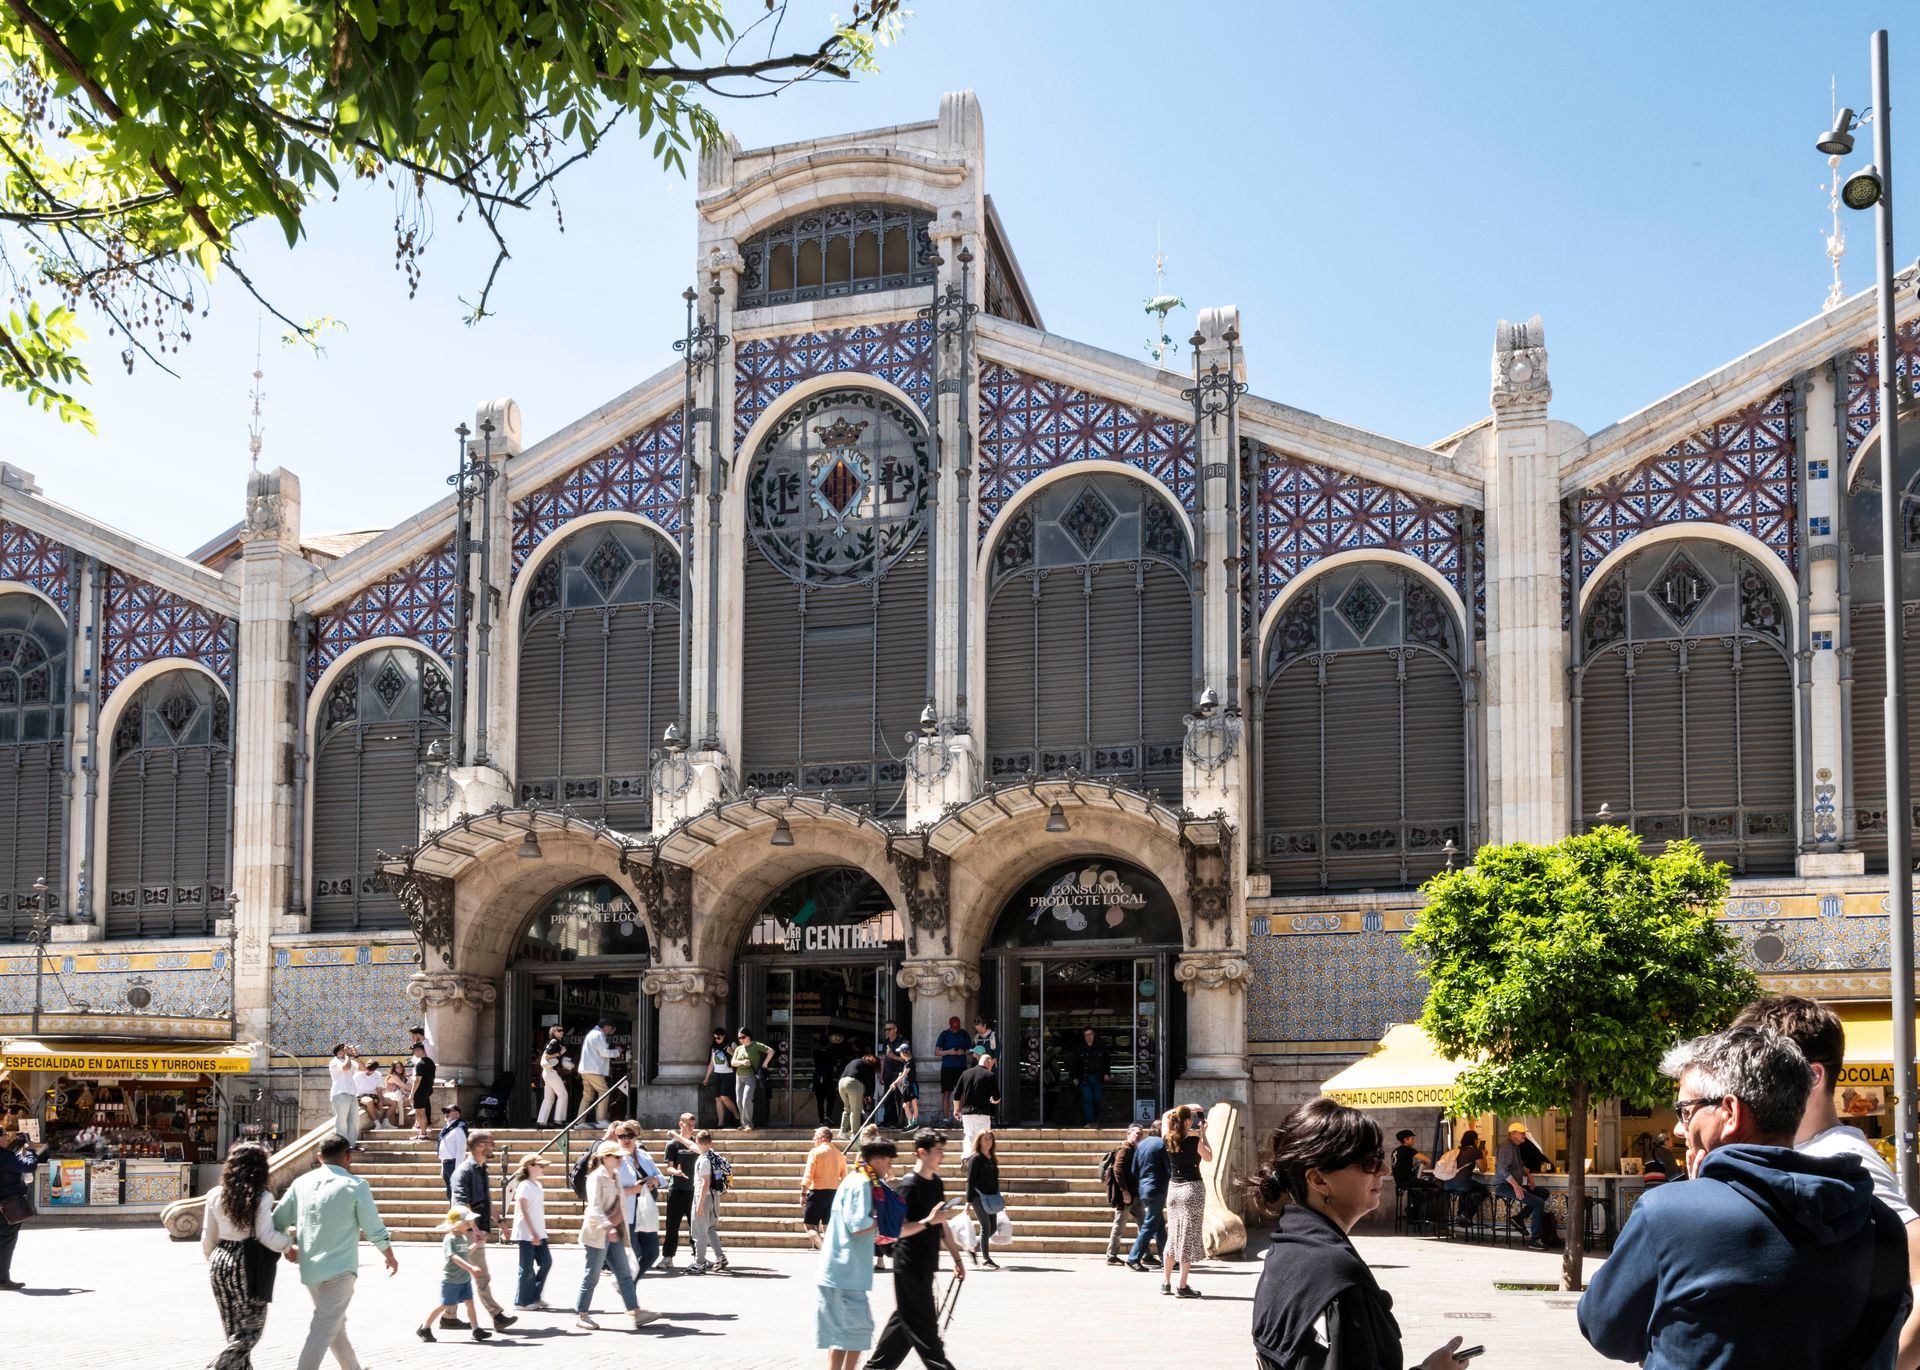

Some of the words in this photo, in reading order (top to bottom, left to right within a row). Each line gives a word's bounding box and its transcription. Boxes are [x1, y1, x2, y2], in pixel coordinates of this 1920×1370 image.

[1052, 883, 1125, 896] CONSUMIX
[1030, 894, 1100, 907] PRODUCTE
[1103, 893, 1148, 905] LOCAL
[569, 901, 632, 914] CONSUMIX
[551, 912, 611, 924] PRODUCTE
[805, 925, 888, 950] CENTRAL
[5, 1057, 85, 1069] ESPECIALIDAD
[88, 1058, 103, 1069] EN
[106, 1059, 149, 1070] DATILES
[151, 1059, 158, 1070] Y
[162, 1059, 216, 1070] TURRONES
[1370, 1090, 1414, 1104] CHURROS
